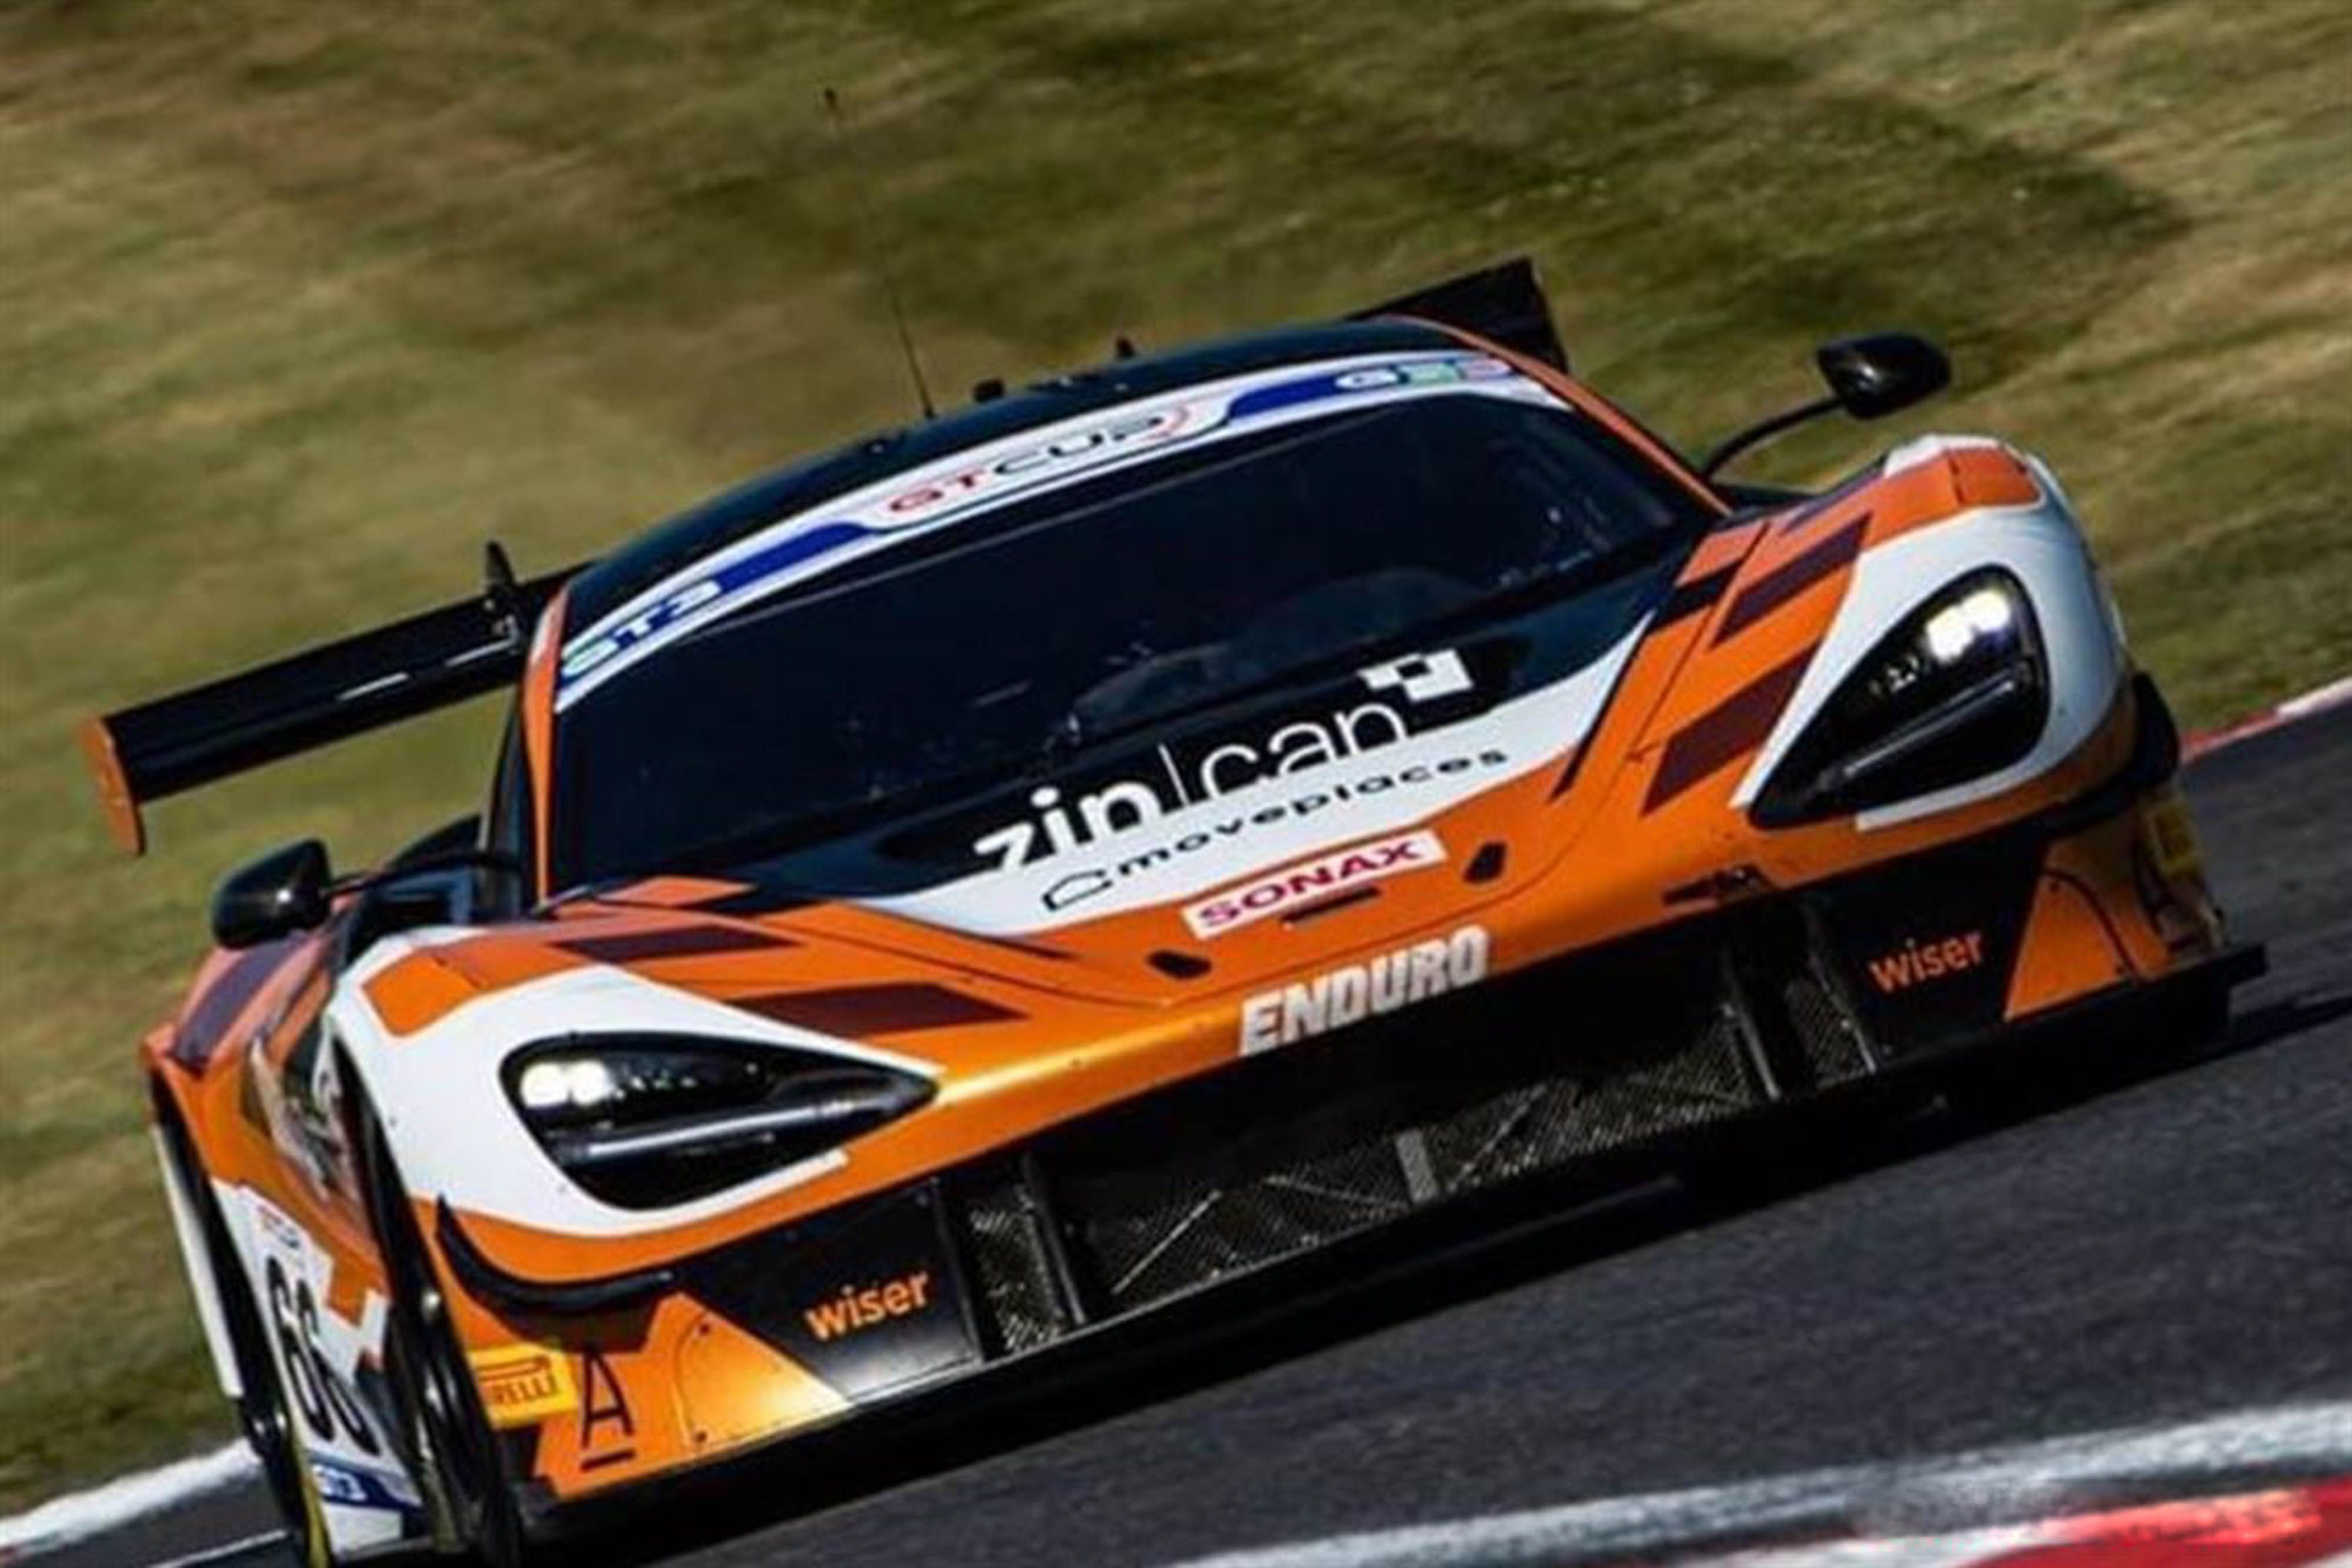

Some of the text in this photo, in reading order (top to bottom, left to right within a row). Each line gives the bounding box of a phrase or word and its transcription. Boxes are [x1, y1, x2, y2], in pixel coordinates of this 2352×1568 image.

[1118, 750, 1508, 875] moveplaces
[1200, 840, 1425, 927] SONAX
[1240, 924, 1489, 1057] ENDURO
[1868, 931, 1984, 994] wiser
[805, 1272, 930, 1340] wiser
